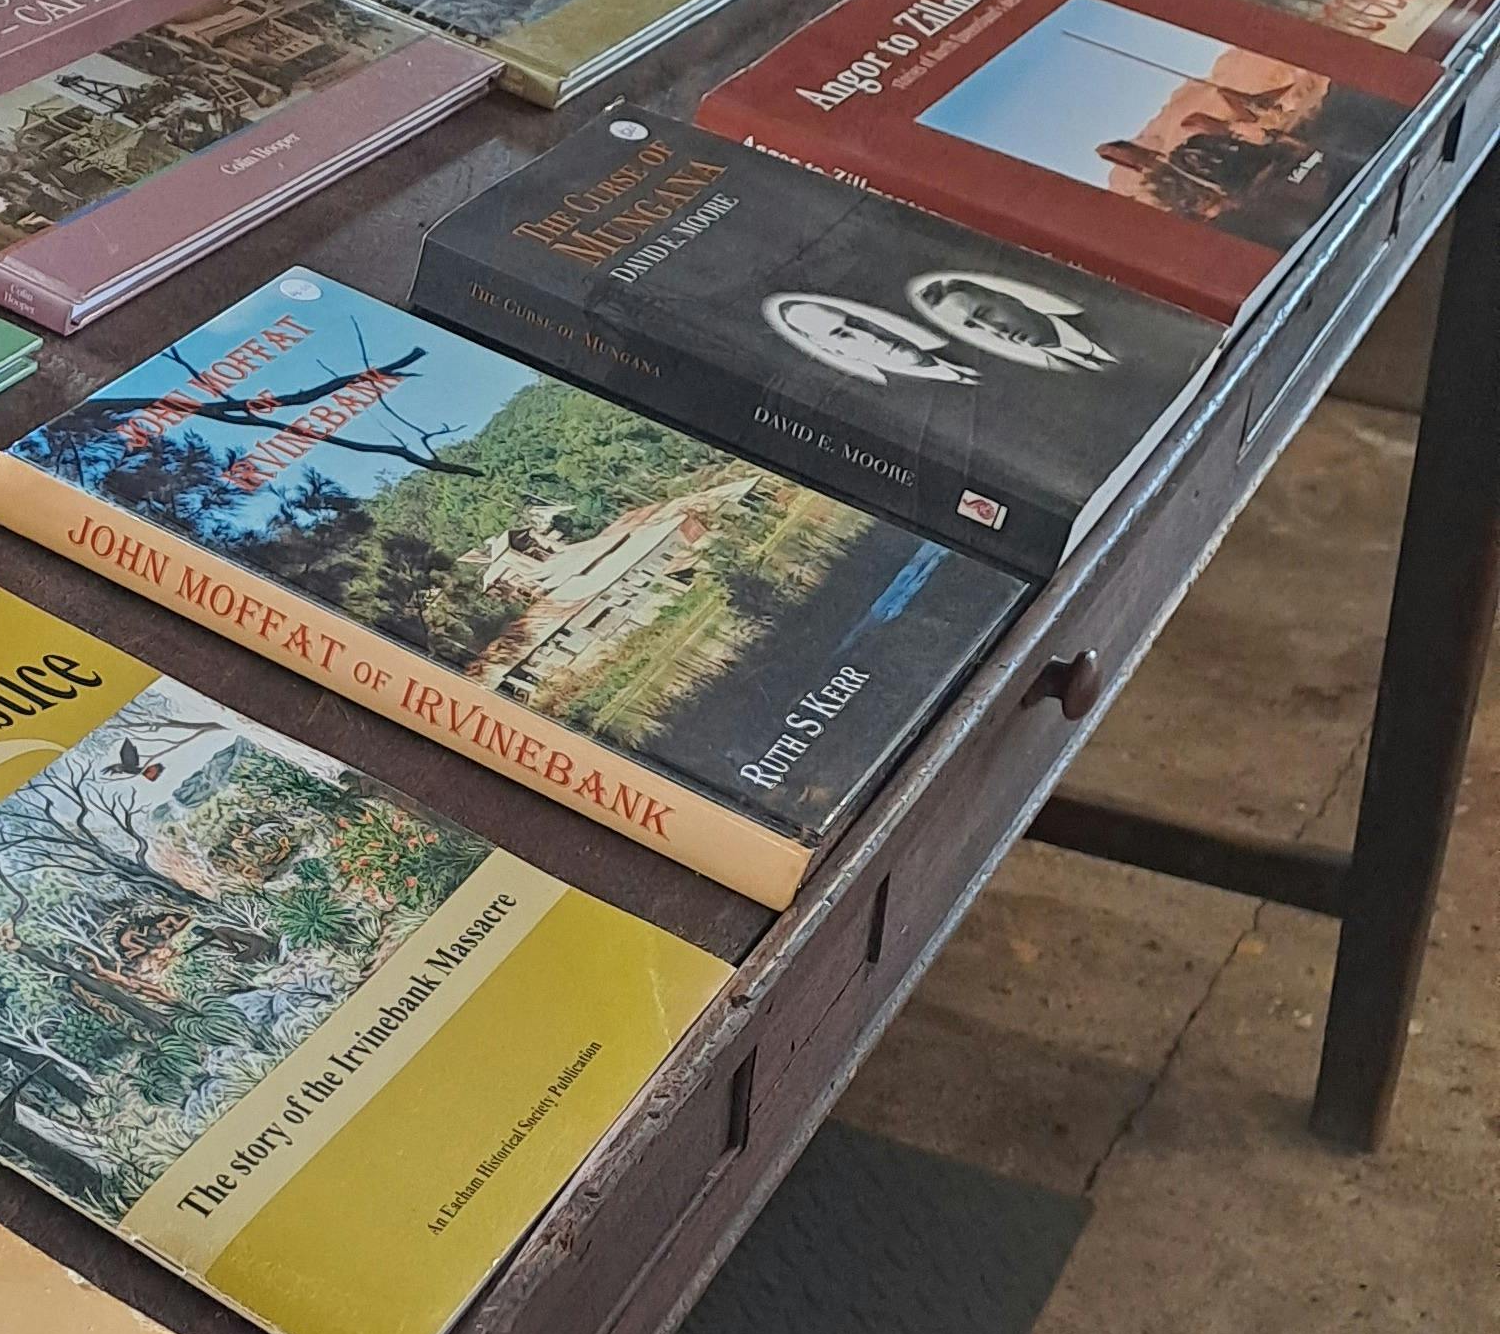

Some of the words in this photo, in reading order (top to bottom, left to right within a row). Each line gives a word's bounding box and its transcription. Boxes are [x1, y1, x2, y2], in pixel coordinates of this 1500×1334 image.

[796, 51, 893, 113] Angor
[877, 33, 920, 58] to
[512, 210, 580, 245] THE
[563, 165, 649, 214] CURSE
[638, 138, 677, 168] OF
[551, 160, 729, 269] MUNGANA
[608, 237, 673, 284] DAVID
[671, 192, 741, 240] MOORE
[115, 389, 203, 452] JOHN
[187, 314, 316, 399] MOFFAT
[583, 331, 662, 379] MUNGANA
[222, 366, 404, 492] IRVINEBANK
[246, 388, 282, 415] OF
[753, 405, 815, 443] DAVID
[817, 433, 835, 453] E.
[841, 443, 917, 488] MOORE
[67, 514, 172, 588] JOHN
[174, 564, 348, 675] MOFFAT
[352, 659, 395, 694] OF
[400, 676, 676, 842] IRVINEBANK
[800, 665, 871, 719] KERR
[740, 733, 811, 790] RUTH
[785, 712, 825, 739] S
[176, 1171, 238, 1219] The
[229, 1120, 295, 1176] story
[282, 1093, 314, 1126] of
[300, 1068, 345, 1104] the
[326, 971, 442, 1075] Irvinebank
[424, 892, 518, 978] Massacre
[426, 1216, 450, 1236] An
[438, 1175, 485, 1219] Eacham
[475, 1126, 528, 1180] Historical
[517, 1095, 561, 1133] Society
[547, 1040, 603, 1098] Publication
